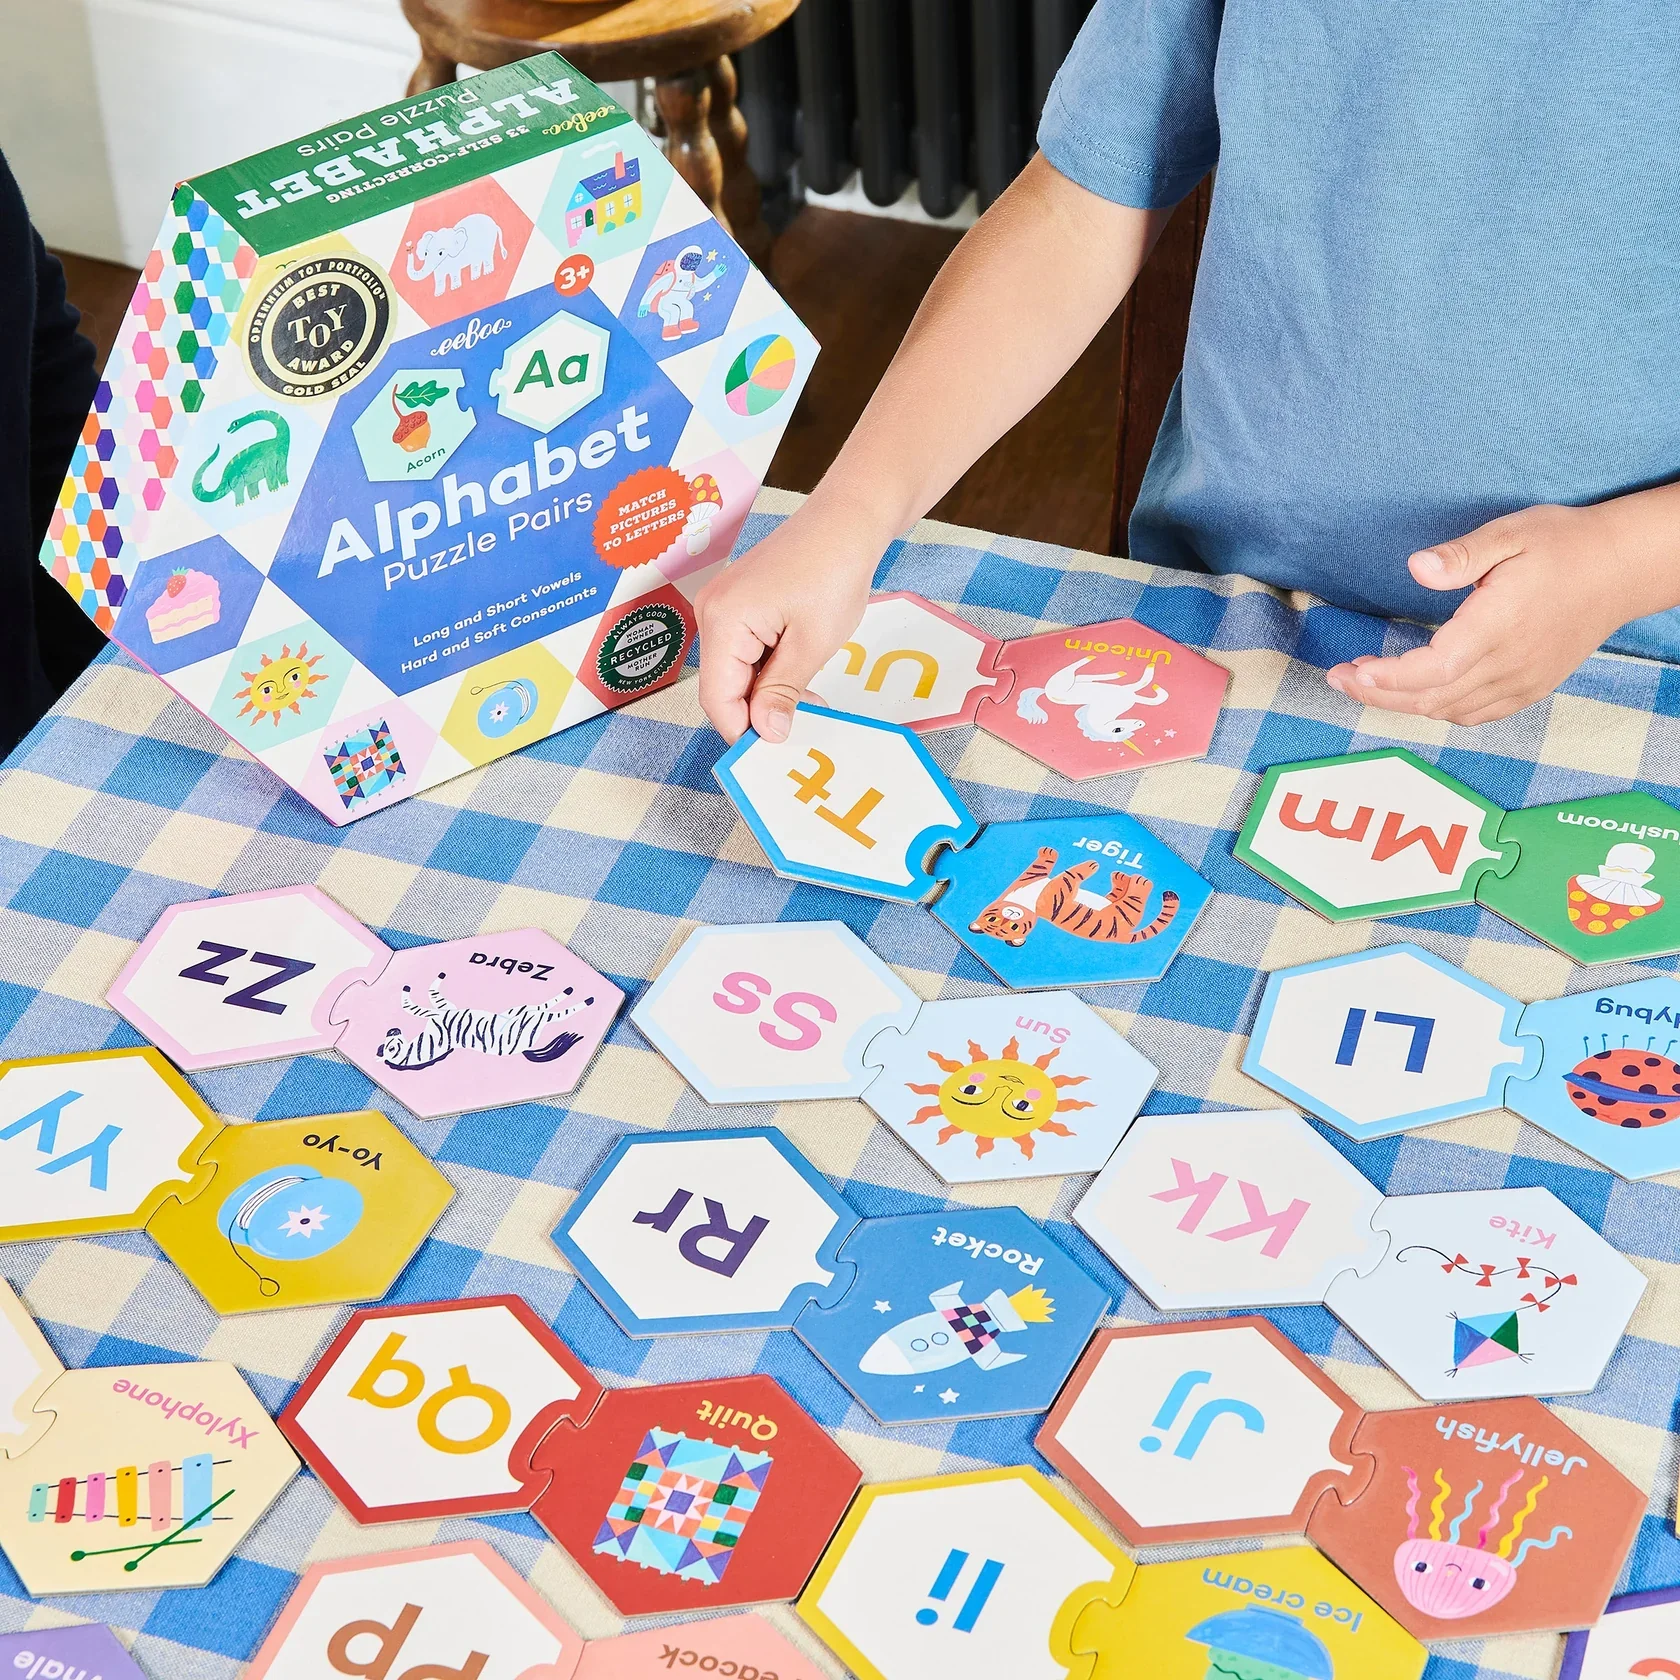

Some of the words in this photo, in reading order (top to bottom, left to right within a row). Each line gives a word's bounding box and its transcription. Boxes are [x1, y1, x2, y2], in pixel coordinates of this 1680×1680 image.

[379, 87, 480, 126] Puzzle
[233, 77, 581, 220] ALPHABET
[296, 122, 378, 157] Pairs
[505, 124, 531, 138] 33
[325, 132, 504, 204] SELF-CORRECTING
[559, 261, 591, 290] 3+
[250, 277, 295, 343] OPPENHEIM
[297, 262, 323, 279] TOY
[292, 284, 341, 310] BEST
[287, 304, 348, 348] TOY
[287, 339, 354, 372] AWARD
[513, 349, 590, 394] Aa
[282, 384, 325, 396] GOLD
[330, 360, 367, 389] SEAL
[405, 446, 447, 474] Acorn
[316, 405, 653, 579] Alphabet
[618, 488, 667, 517] MATCH
[603, 536, 622, 551] TO
[625, 509, 685, 542] LETTERS
[609, 498, 677, 535] PICTURES
[382, 529, 497, 592] Puzzle
[507, 491, 593, 542] Pairs
[413, 626, 450, 648] Long
[454, 611, 483, 631] and
[486, 592, 528, 617] Short
[531, 571, 582, 598] Vowels
[613, 614, 643, 640] ALWAYS
[645, 611, 667, 619] GOOD
[401, 649, 438, 674] Hard
[441, 637, 470, 657] and
[474, 624, 507, 644] Soft
[510, 586, 598, 628] Consonants
[610, 633, 672, 665] RECYCLED
[625, 623, 654, 639] WOMAN
[627, 629, 654, 644] OWNED
[627, 653, 657, 669] MOTHER
[635, 661, 650, 672] RUN
[1064, 637, 1173, 666] Unicorn
[634, 674, 652, 684] YORK
[653, 660, 667, 674] CITY
[786, 747, 885, 850] Tt
[1278, 792, 1469, 876] Mm
[1557, 811, 1680, 845] ushroom
[1071, 836, 1147, 870] Tiger
[177, 940, 317, 1016] Zz
[468, 952, 557, 983] Zebra
[712, 971, 839, 1052] Ss
[1014, 1015, 1072, 1045] Sun
[1335, 1006, 1436, 1074] Ll
[0, 1090, 123, 1192] Yy
[302, 1132, 385, 1172] Yo-yo
[1148, 1157, 1312, 1260] Kk
[632, 1188, 770, 1278] Rr
[932, 1226, 1045, 1277] Rocket
[1488, 1214, 1558, 1251] Kite
[347, 1331, 512, 1455] Qq
[112, 1377, 261, 1450] Xylophone
[696, 1399, 778, 1442] Quilt
[1139, 1370, 1266, 1461] Jj
[1435, 1416, 1589, 1477] Jellyfish
[915, 1548, 1005, 1634] Ii
[1202, 1566, 1306, 1607] cream
[1314, 1600, 1365, 1633] Ice
[657, 1643, 780, 1680] eacock
